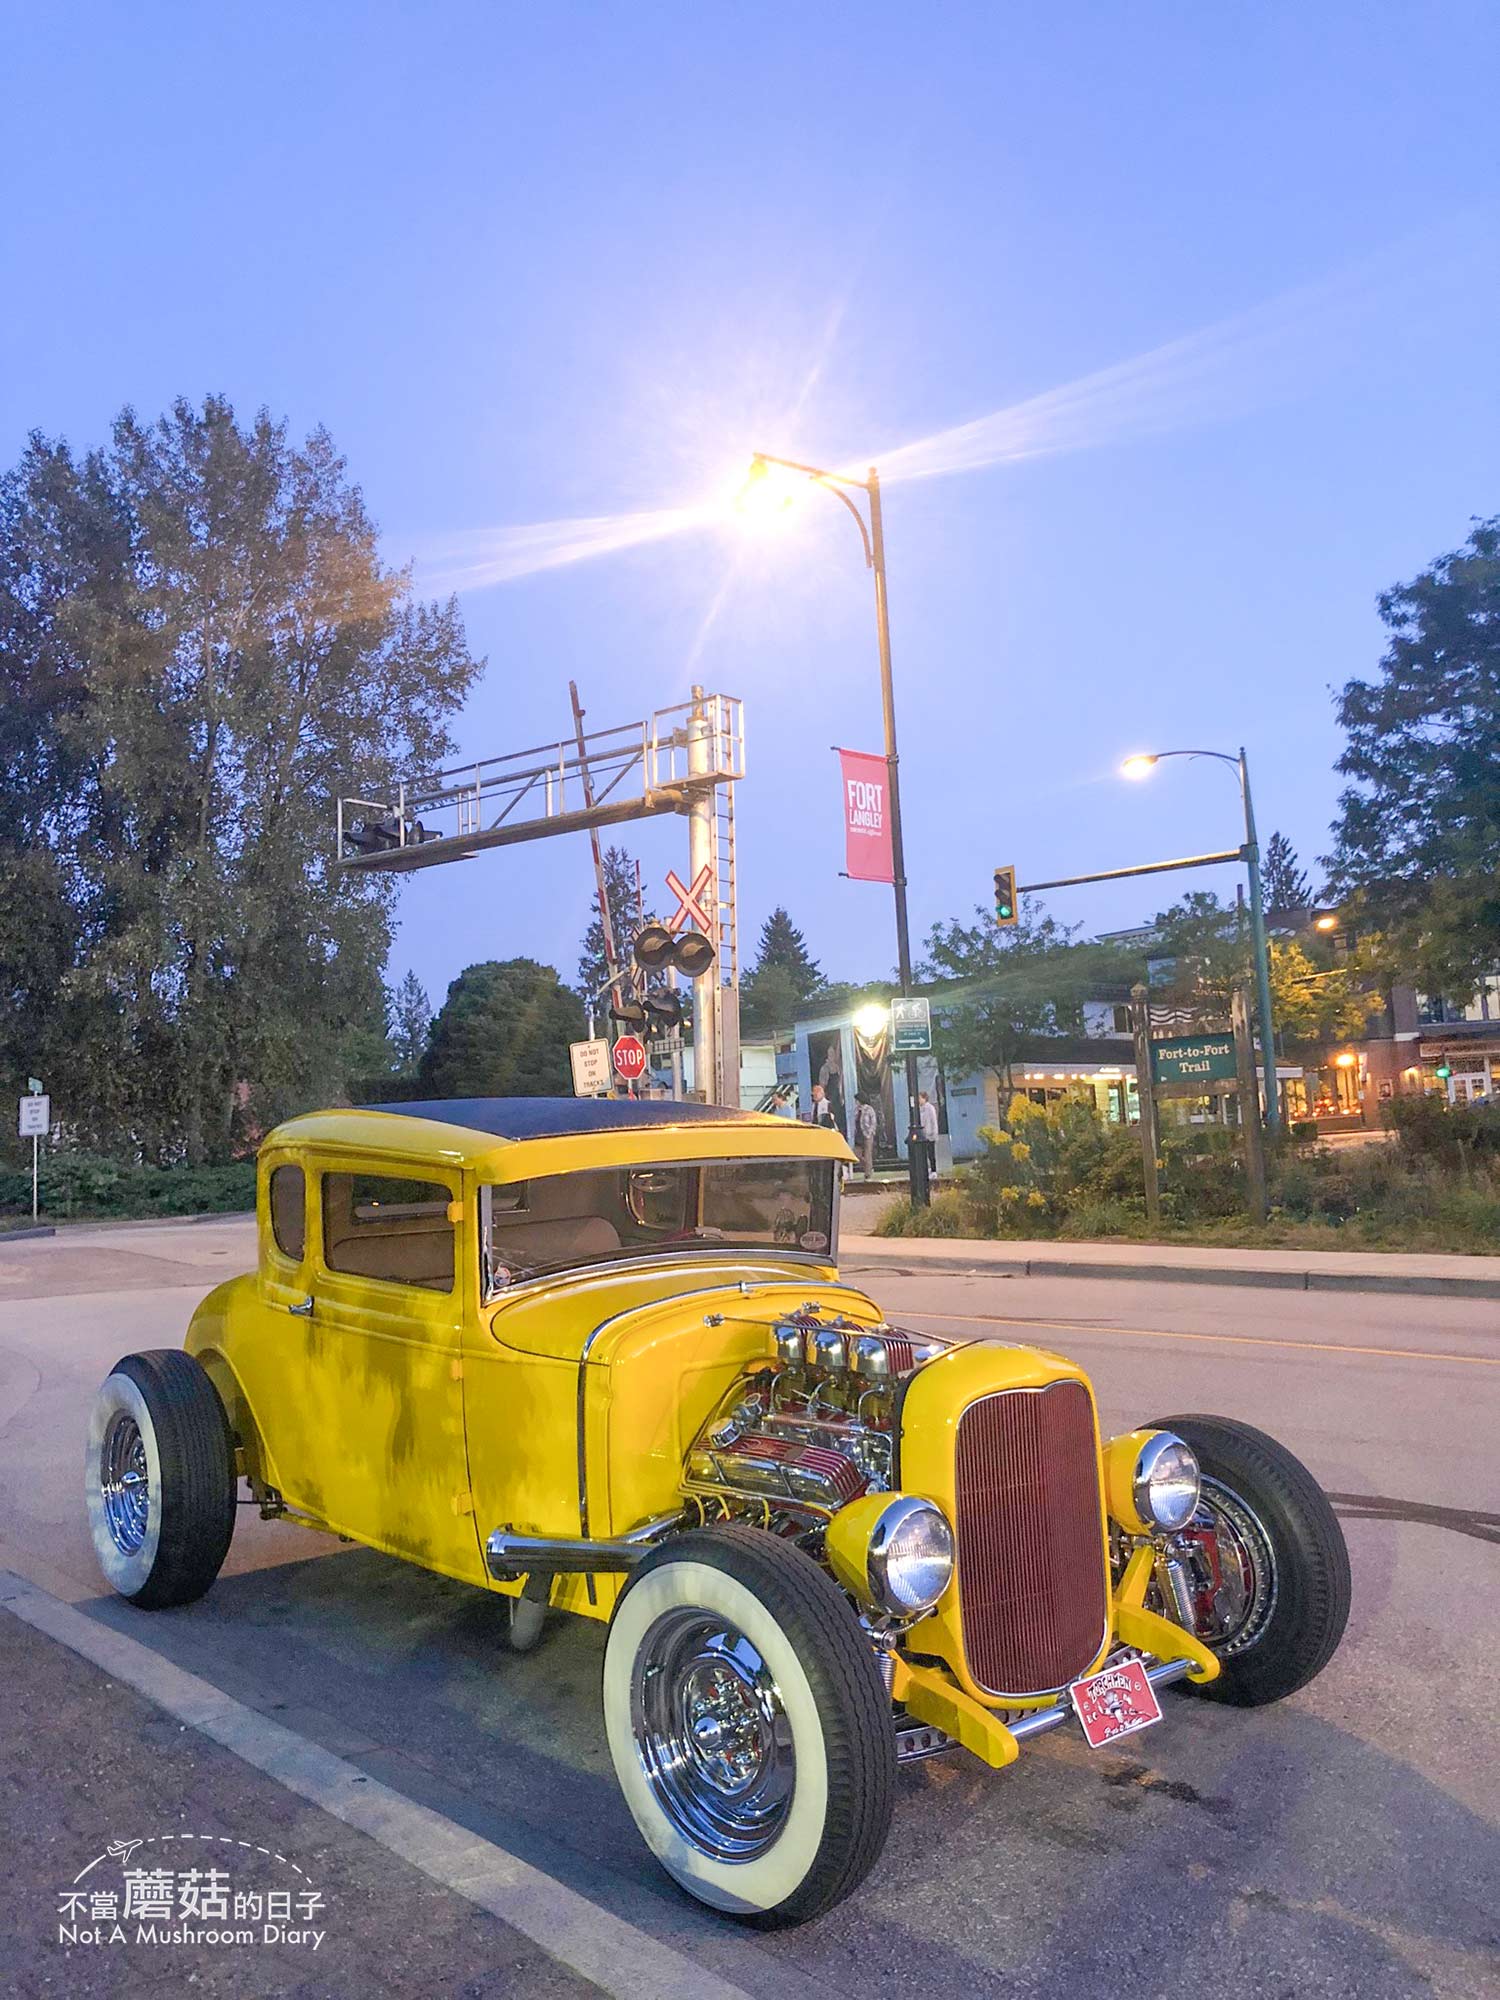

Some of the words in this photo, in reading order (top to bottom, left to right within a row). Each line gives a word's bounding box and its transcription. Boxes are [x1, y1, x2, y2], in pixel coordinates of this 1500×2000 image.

[847, 779, 883, 812] FORT
[849, 808, 882, 829] LANGLEY
[589, 1048, 600, 1056] NOT
[616, 1049, 643, 1066] STOP
[1158, 1043, 1230, 1060] Fort-to-Fort
[584, 1059, 598, 1068] STOP
[1179, 1060, 1211, 1073] Trail
[583, 1080, 605, 1088] TRACKS
[1087, 1672, 1132, 1704] TORCHMEN
